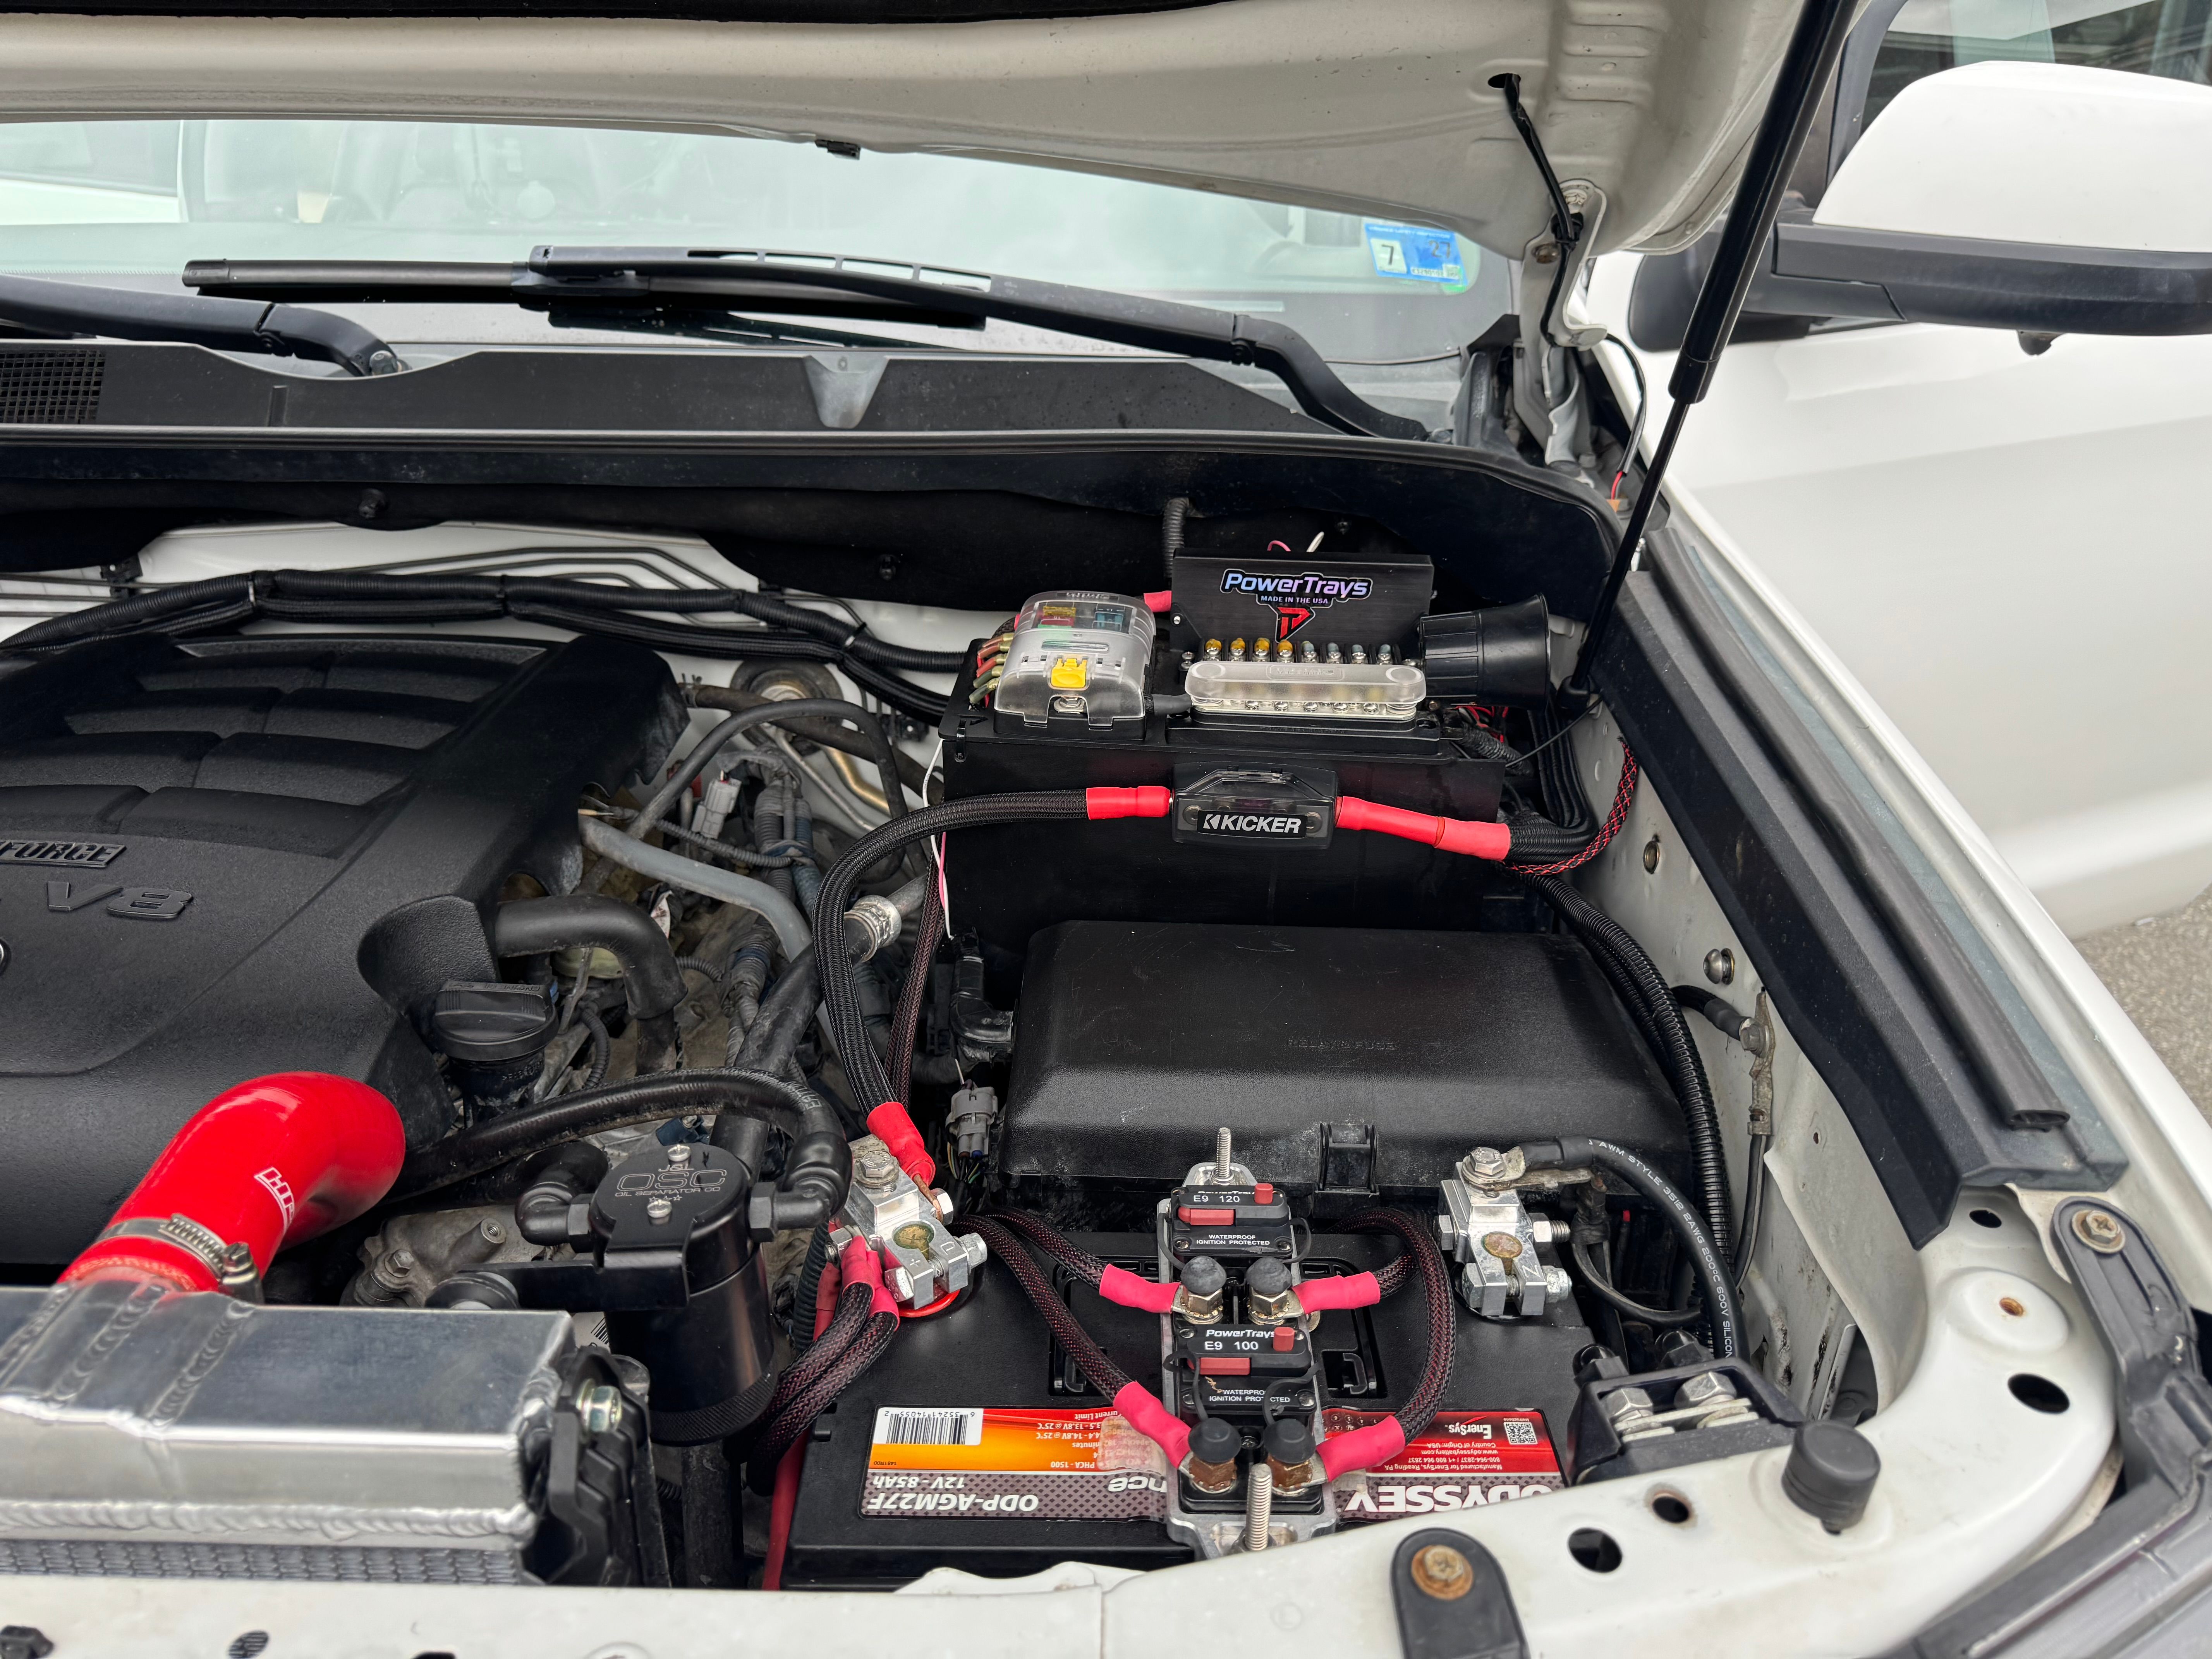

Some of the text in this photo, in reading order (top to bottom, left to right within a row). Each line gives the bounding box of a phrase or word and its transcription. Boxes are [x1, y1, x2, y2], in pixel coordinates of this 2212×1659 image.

[1381, 244, 1394, 265] 7
[1429, 240, 1450, 259] 27
[1224, 573, 1368, 598] PowerTrays
[1221, 815, 1301, 833] KICKER
[47, 881, 193, 920] V8
[617, 1169, 727, 1191] OSC
[635, 1187, 701, 1196] SEPARATOR
[1599, 1141, 1625, 1156] AWM
[1628, 1155, 1663, 1185] STYLE
[1663, 1187, 1684, 1211] 3512
[1683, 1212, 1705, 1243] 2AWG
[1716, 1286, 1729, 1316] 600V
[1206, 1329, 1274, 1338] PowerTrays
[1205, 1341, 1259, 1350] E9 100
[1448, 1422, 1492, 1439] EnerSys
[873, 1476, 920, 1488] 85Ah
[930, 1477, 965, 1489] 12V
[867, 1493, 1039, 1511] ODP-AGM27F
